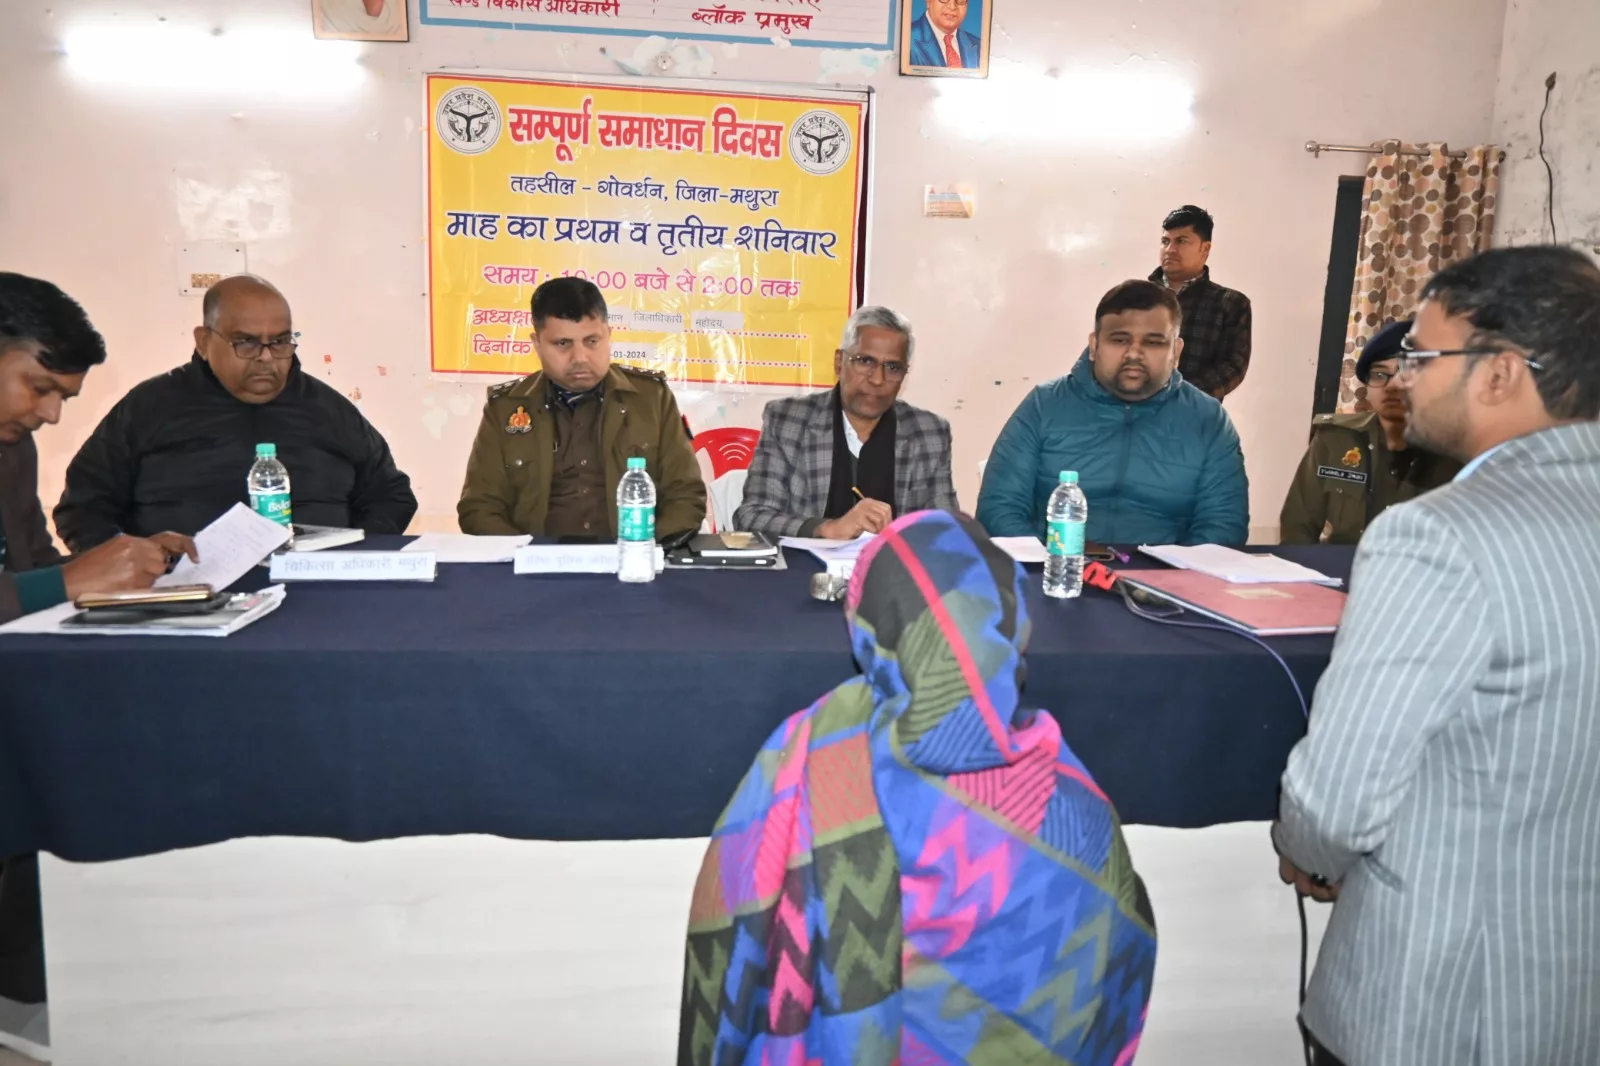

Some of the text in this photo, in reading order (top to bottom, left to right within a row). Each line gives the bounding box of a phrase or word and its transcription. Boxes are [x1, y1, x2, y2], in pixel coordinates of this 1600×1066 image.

[691, 4, 747, 26] ब्लॉक
[754, 12, 814, 35] प्रमुख
[508, 98, 784, 161] सम्पूर्ण समाधान दिवस
[510, 171, 577, 195] तहसील
[447, 211, 837, 259] माह का प्रथम व तृतीय शनिवार
[483, 265, 539, 286] समय
[634, 266, 671, 291] बजे
[675, 268, 697, 293] से
[702, 275, 754, 296] 2:00
[760, 279, 801, 298] तक
[472, 309, 534, 326] अध्यक्ष
[473, 333, 646, 359] दिनांक -01-2024
